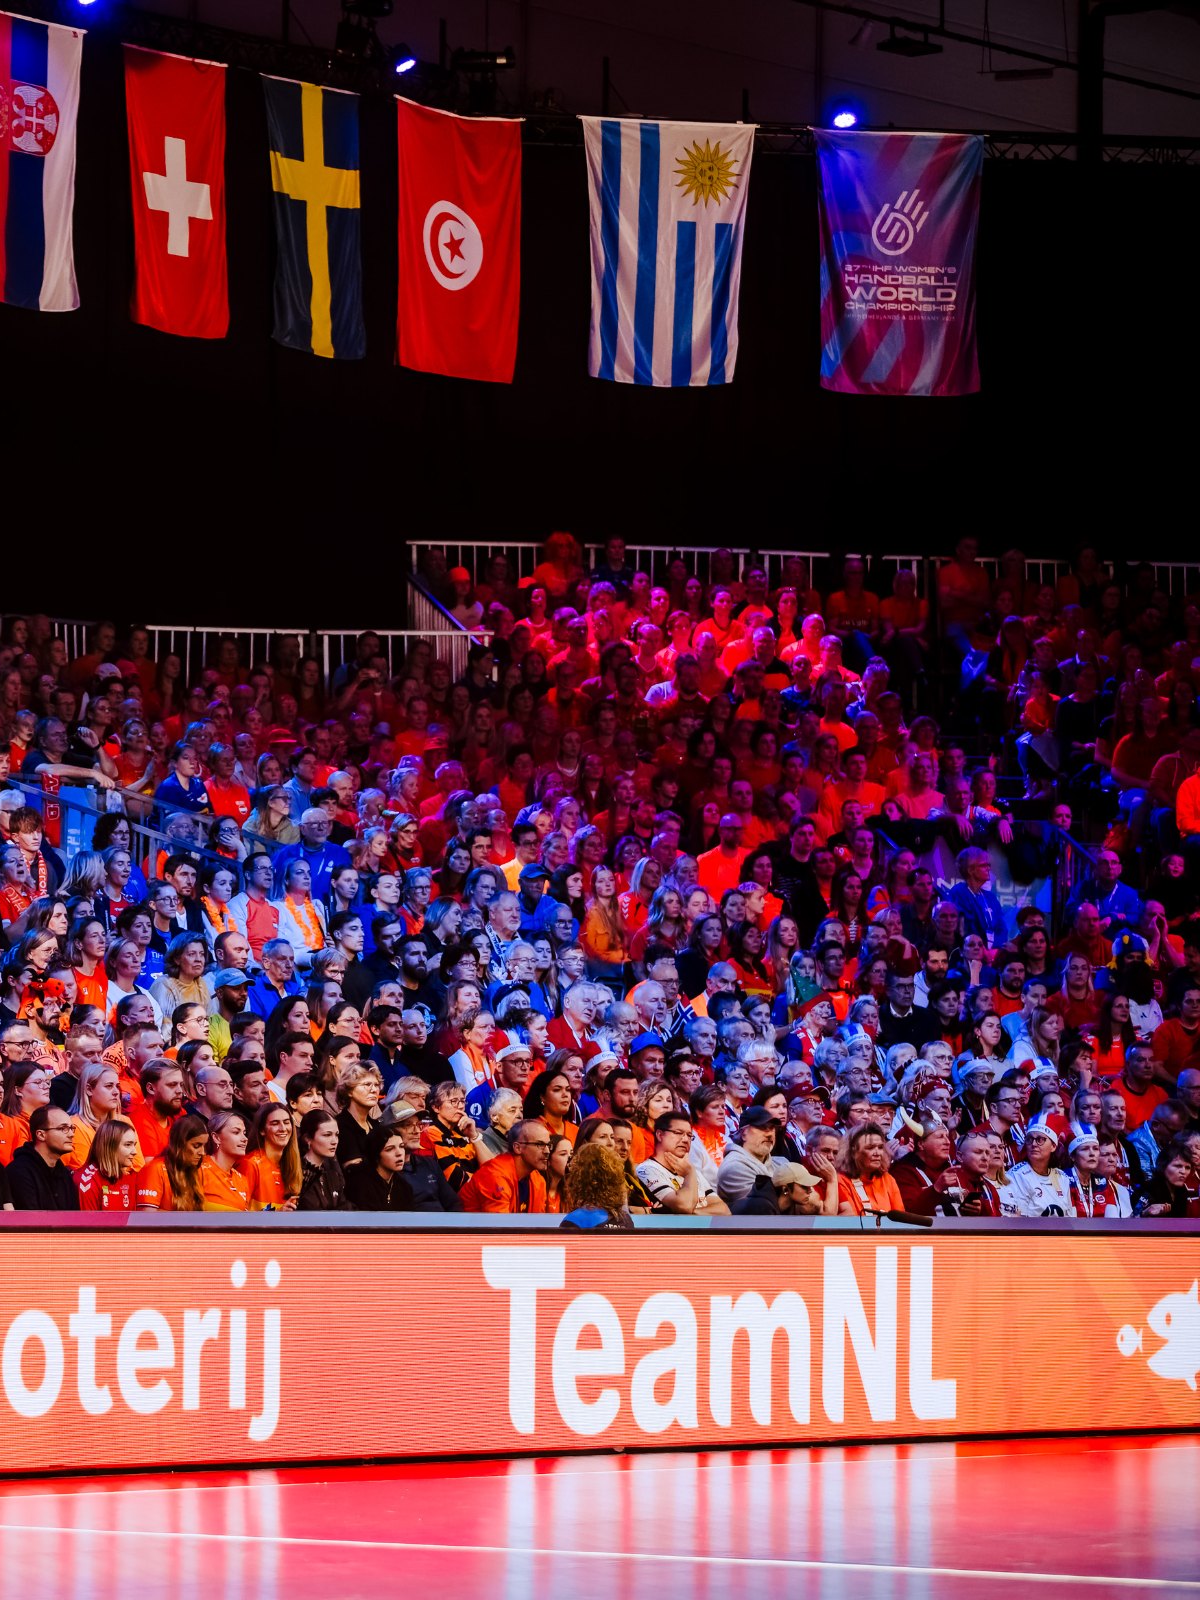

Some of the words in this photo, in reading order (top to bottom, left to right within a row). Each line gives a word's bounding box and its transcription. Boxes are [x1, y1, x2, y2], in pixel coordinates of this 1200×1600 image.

[872, 265, 893, 273] IHF
[894, 265, 957, 274] WOMEN'S
[844, 273, 957, 286] HANDBALL
[845, 285, 957, 302] WORLD
[844, 301, 956, 312] CHAMPIONSHIP
[481, 1245, 958, 1436] TeamNL
